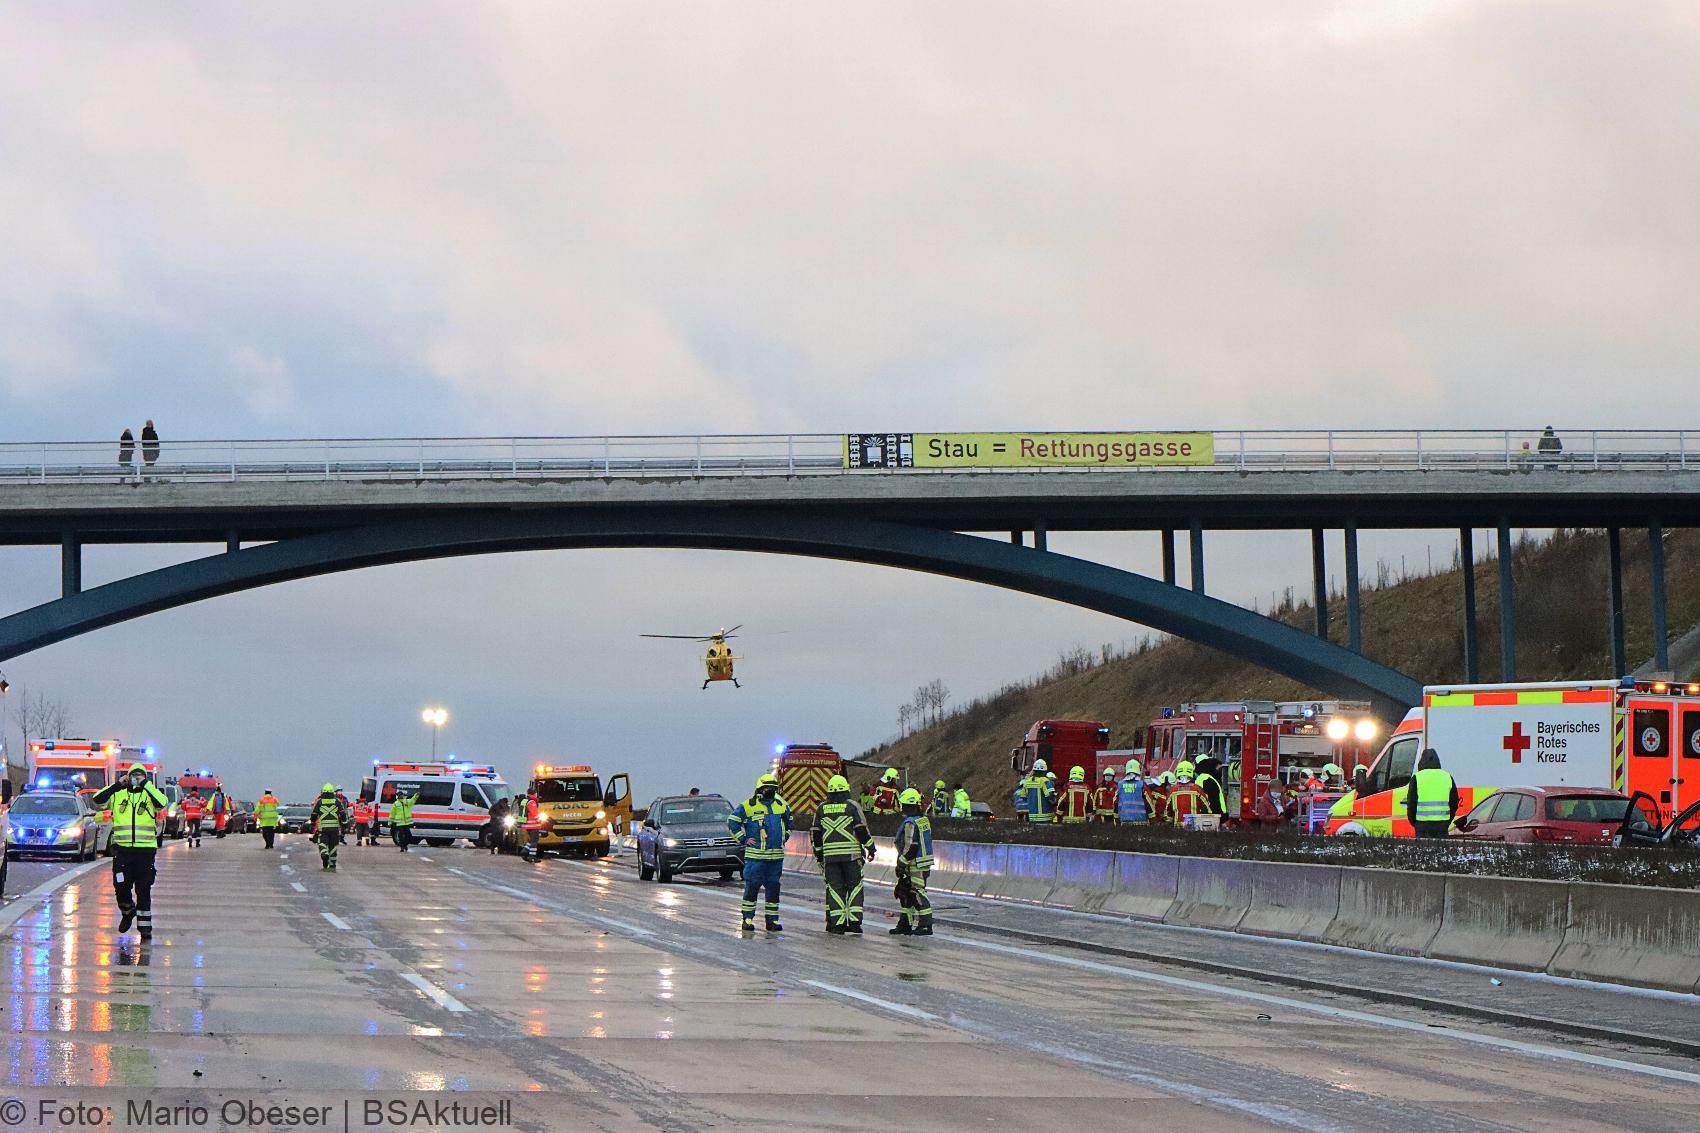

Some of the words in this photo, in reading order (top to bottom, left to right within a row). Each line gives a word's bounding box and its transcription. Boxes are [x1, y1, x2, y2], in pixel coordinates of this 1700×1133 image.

[928, 438, 978, 457] Stau
[1020, 438, 1193, 462] Rettungsgasse
[1537, 721, 1600, 735] Bayerisches
[1537, 736, 1567, 748] Rotes
[1537, 751, 1567, 763] Kreuz
[553, 803, 590, 811] ADAC
